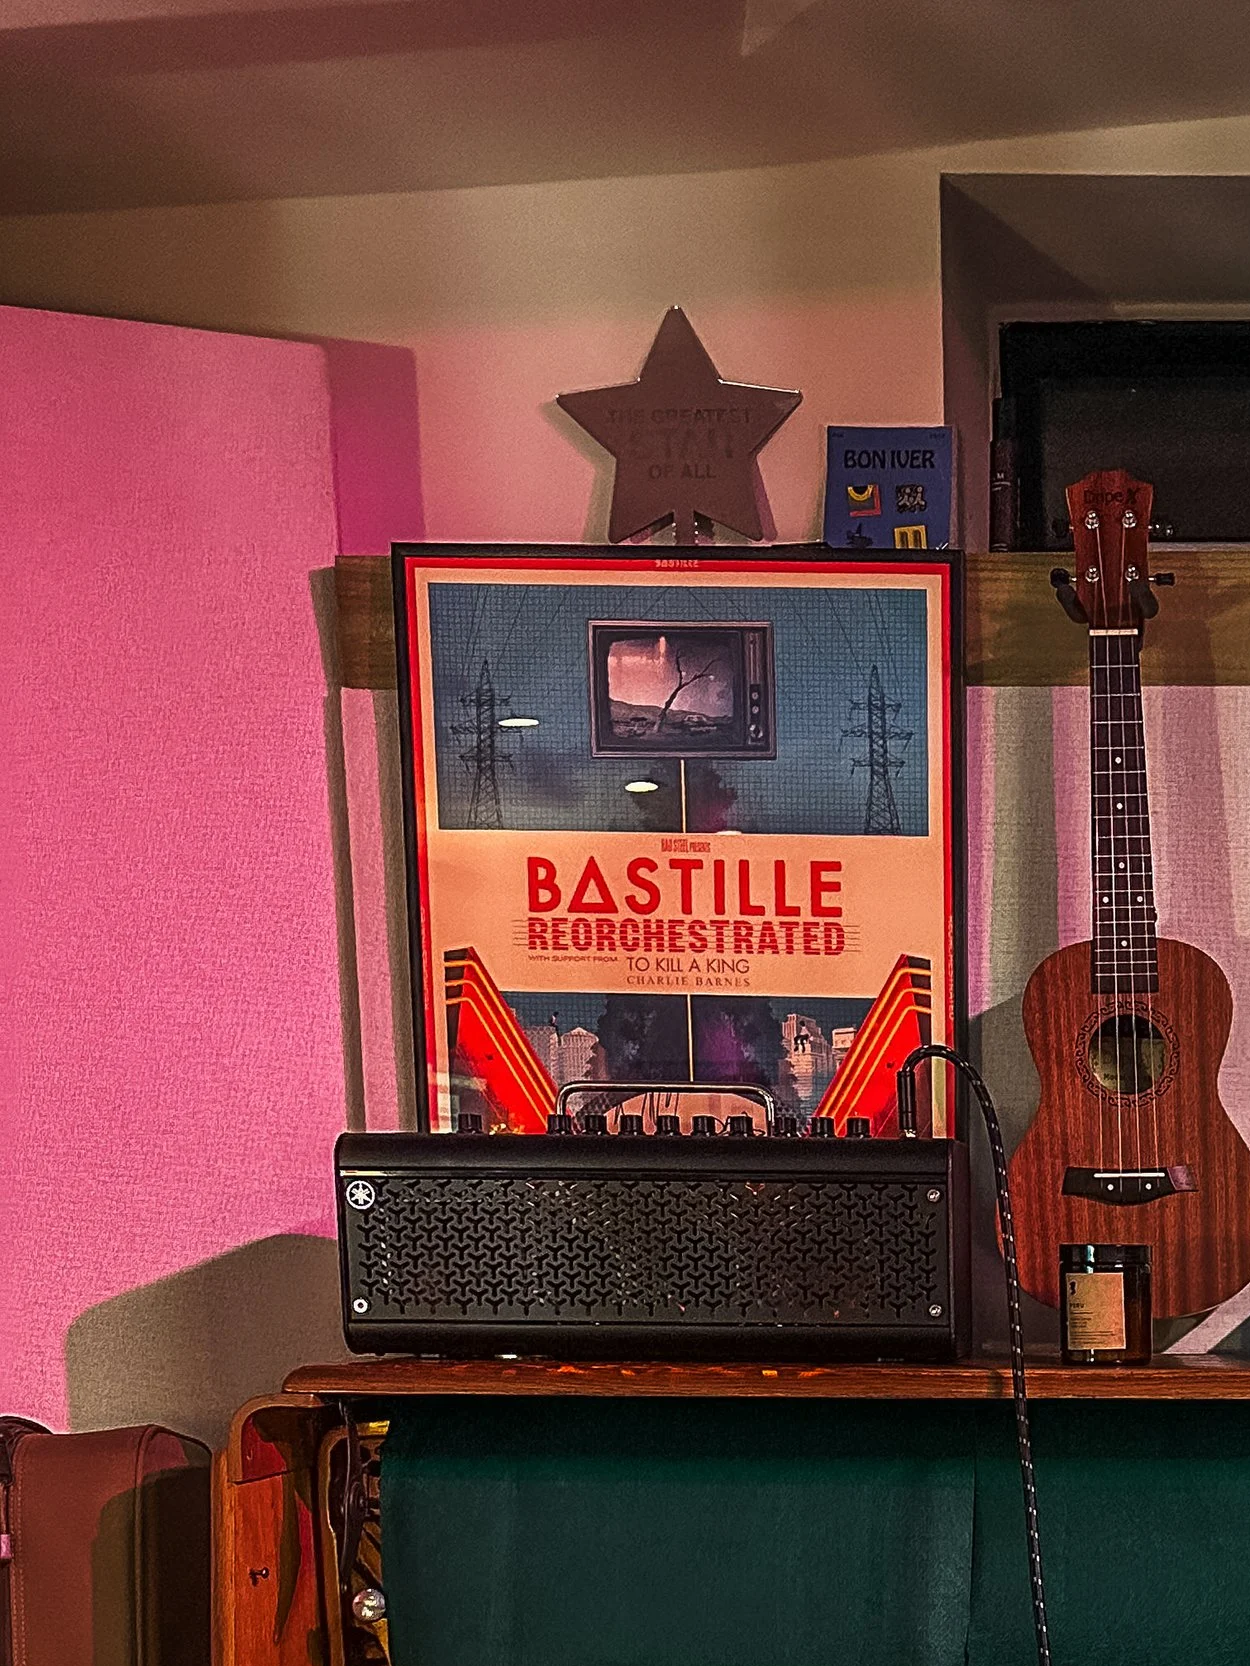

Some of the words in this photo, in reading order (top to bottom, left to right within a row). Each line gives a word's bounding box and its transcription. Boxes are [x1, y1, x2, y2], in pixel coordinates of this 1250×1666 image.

[650, 408, 753, 424] GREATEST
[843, 449, 886, 470] BON
[889, 449, 936, 470] IVER
[648, 464, 674, 480] OF
[680, 464, 718, 480] ALL
[526, 855, 844, 918] BASTILLE
[526, 916, 847, 956] REORCHESTRATED
[528, 954, 550, 962] WITH
[551, 955, 591, 963] SUPPORT
[593, 955, 618, 963] FROM
[626, 956, 650, 972] TO
[655, 957, 684, 973] KILL
[688, 957, 701, 973] A
[706, 958, 750, 974] KING
[626, 975, 688, 986] CHARLIE
[695, 976, 751, 988] BARNES
